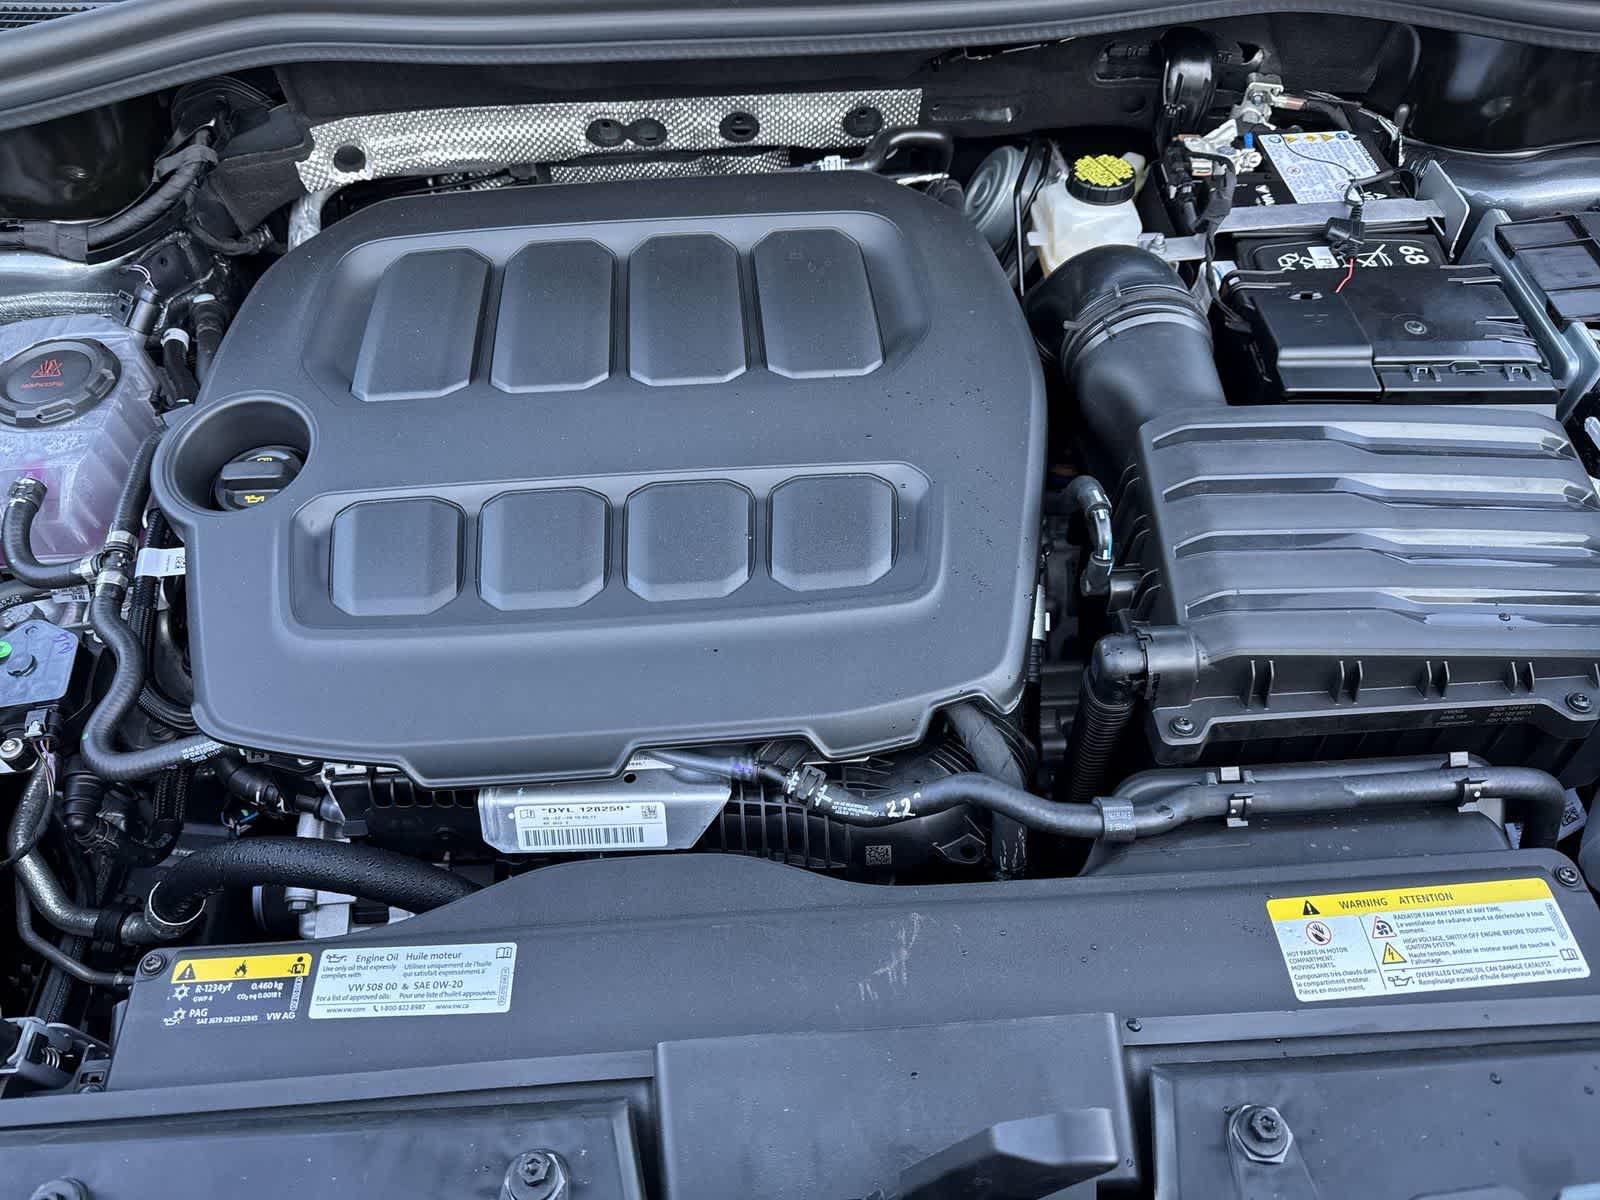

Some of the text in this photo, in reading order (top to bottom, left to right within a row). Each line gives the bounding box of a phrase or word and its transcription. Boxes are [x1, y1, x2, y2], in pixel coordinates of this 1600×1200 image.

[1338, 892, 1454, 909] WARNING ATTENTION
[1393, 912, 1422, 920] RADIATOR
[1480, 930, 1502, 938] ENGINE
[1502, 928, 1525, 936] BEFORE
[356, 953, 399, 964] Engine Oil
[406, 952, 462, 961] Huile moteur
[370, 964, 397, 972] expressly
[428, 962, 464, 970] uniquement
[1294, 972, 1330, 980] Composants
[1416, 970, 1451, 978] OVERFILLED
[348, 983, 365, 992] VW
[366, 983, 383, 992] 508
[385, 982, 398, 991] 00
[414, 981, 431, 990] SAE
[433, 980, 464, 989] 0W-20
[1304, 978, 1346, 987] compartiment
[1418, 978, 1455, 986] Remplissage
[195, 981, 284, 994] R-1234yf 0.460 kg
[249, 993, 258, 1001] eq
[350, 994, 378, 1002] approved
[189, 1008, 209, 1018] PAG
[266, 1011, 296, 1021] VW AG
